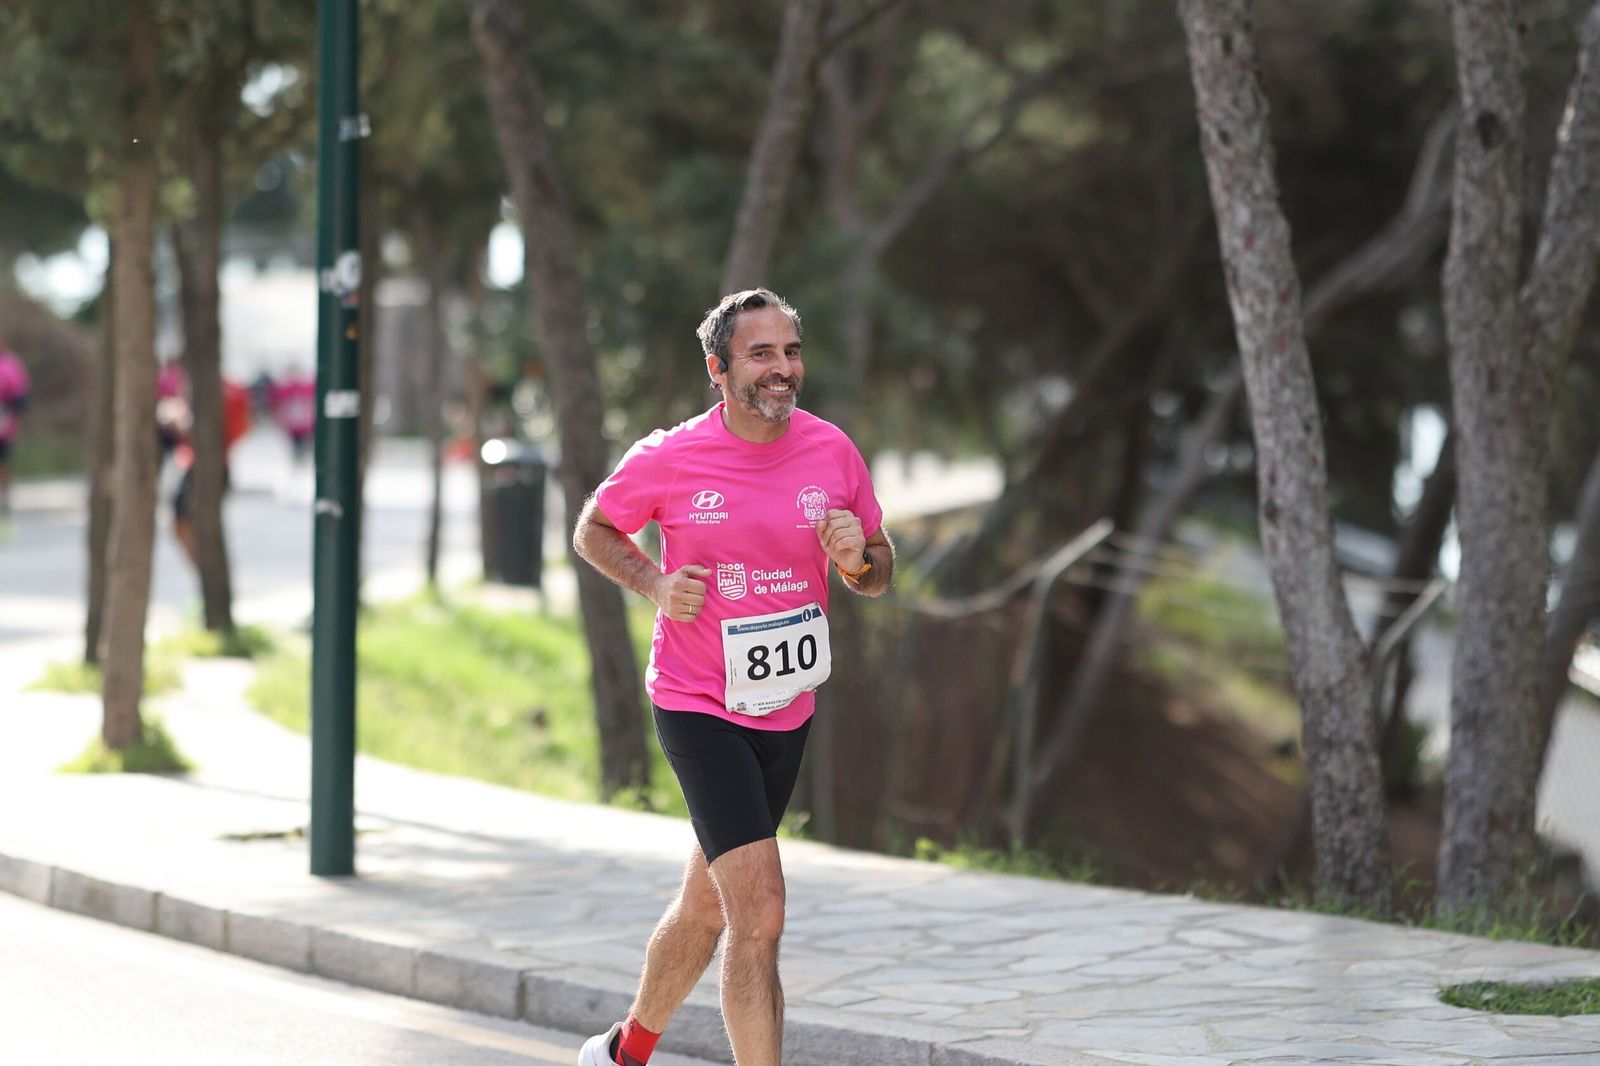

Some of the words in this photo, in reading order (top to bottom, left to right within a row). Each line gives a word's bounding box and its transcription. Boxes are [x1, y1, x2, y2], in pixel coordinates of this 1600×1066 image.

[688, 511, 729, 519] HYUNDAI
[751, 567, 793, 581] Ciudad
[754, 583, 768, 595] de
[770, 580, 808, 594] Málaga
[747, 634, 817, 681] 810
